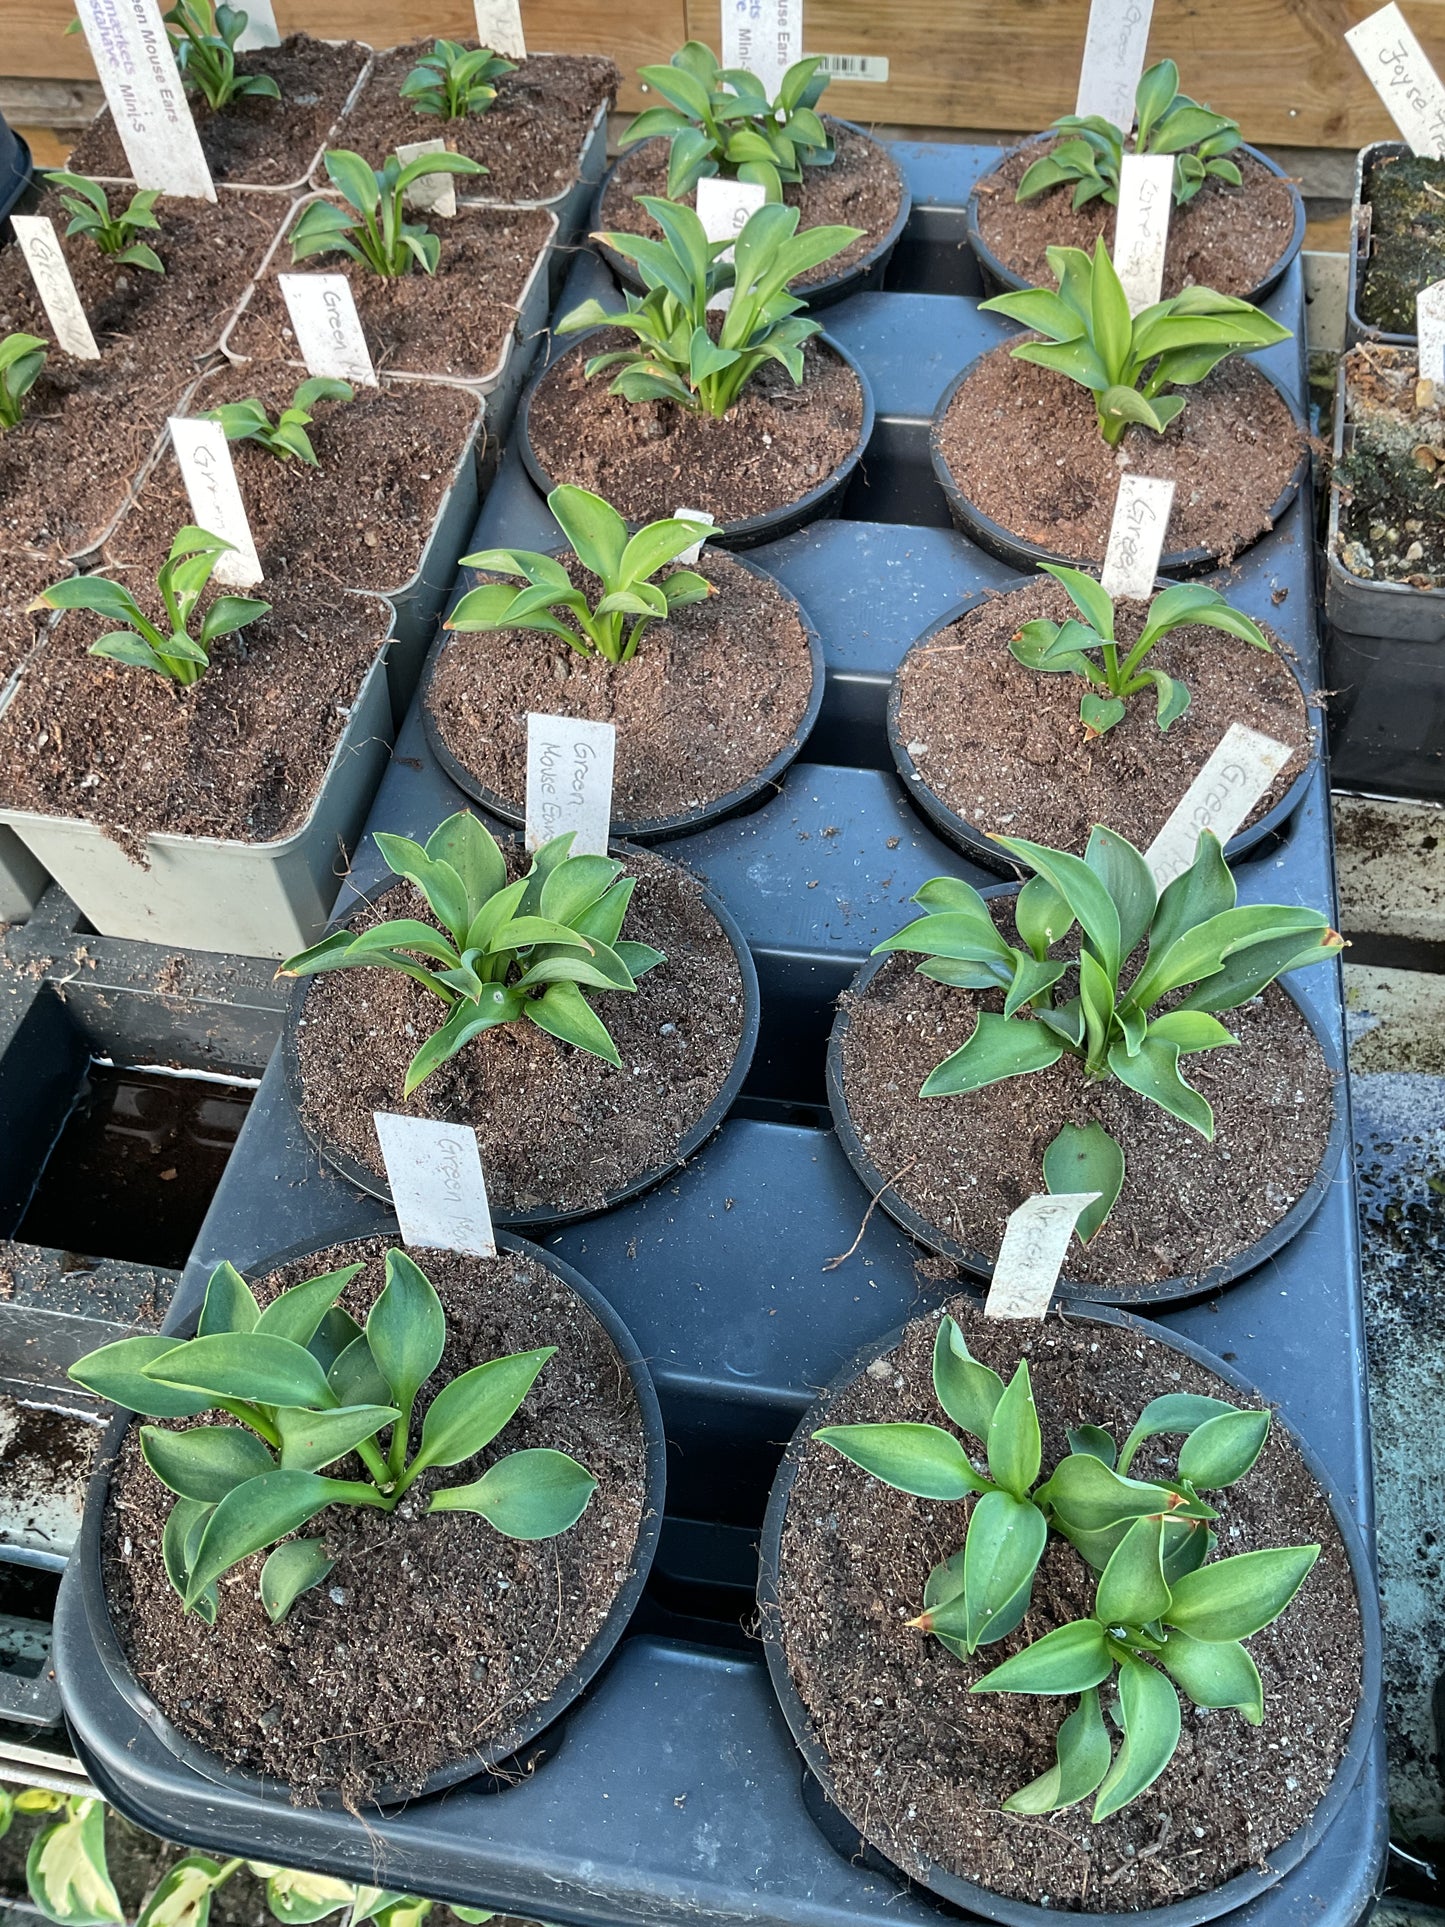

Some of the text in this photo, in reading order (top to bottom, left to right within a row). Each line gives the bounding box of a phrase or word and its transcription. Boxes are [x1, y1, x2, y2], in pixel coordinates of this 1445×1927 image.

[141, 29, 166, 84] Mouse
[159, 88, 179, 124] Ears
[777, 32, 791, 67] Ears
[1378, 39, 1428, 114] Joyse
[322, 290, 348, 351] Green
[539, 742, 563, 796] Mouse
[567, 742, 597, 806] Green
[437, 1137, 464, 1203] Green
